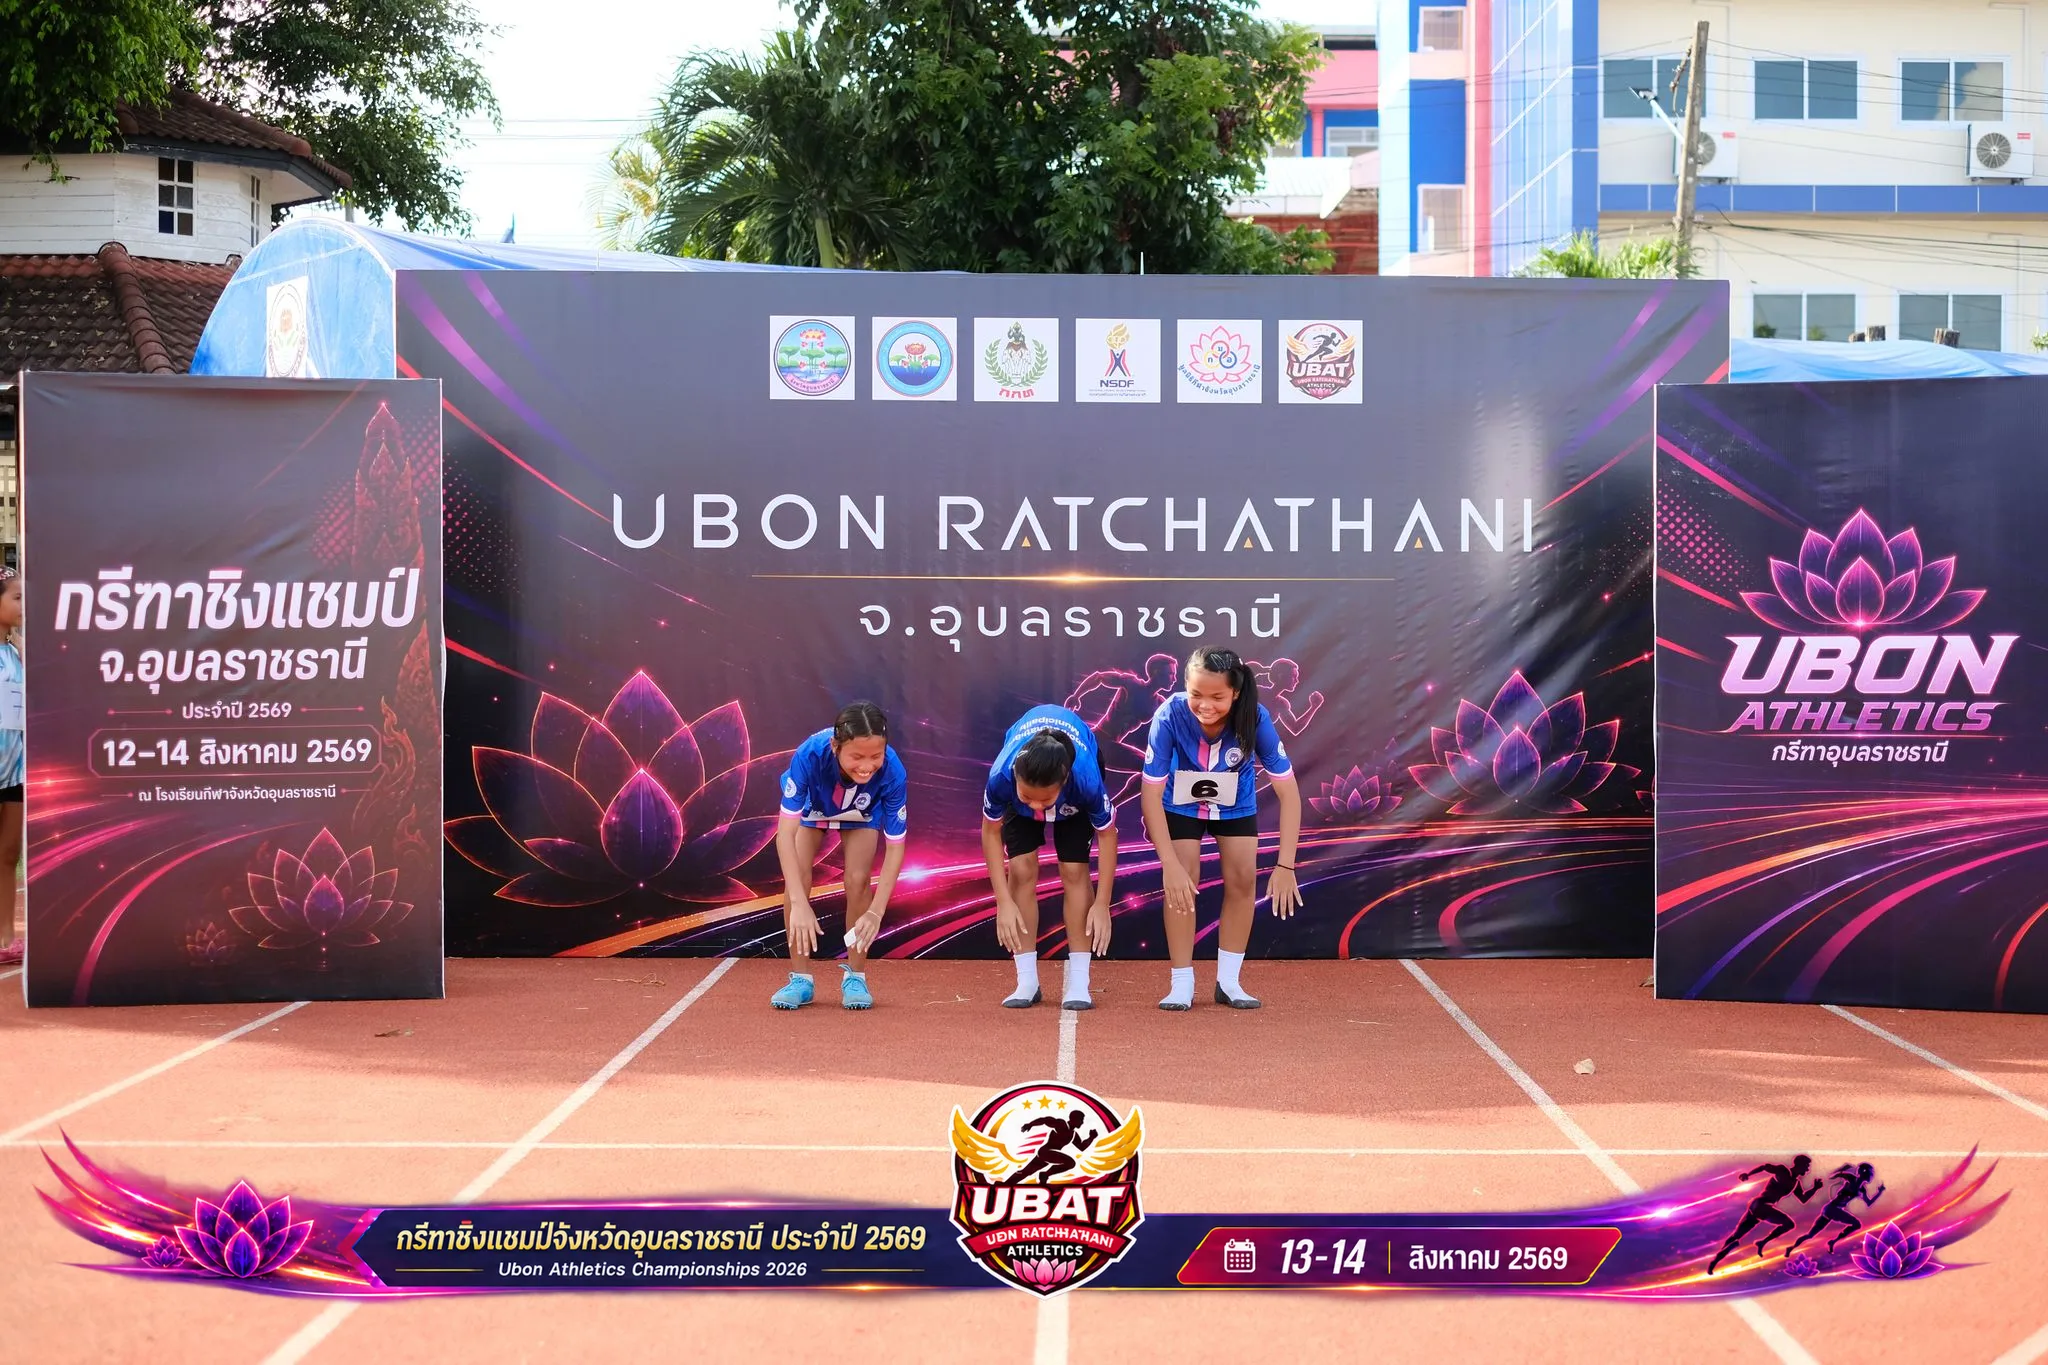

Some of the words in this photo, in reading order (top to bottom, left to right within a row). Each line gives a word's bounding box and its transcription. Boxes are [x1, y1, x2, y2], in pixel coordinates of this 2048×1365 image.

[1099, 379, 1135, 388] NSDF
[1292, 362, 1350, 377] UBAT
[613, 493, 885, 550] UBON
[938, 495, 1532, 552] RATCHATHANI
[859, 593, 1280, 653] จ.อุบลราชธานี
[99, 636, 368, 694] จ.อุบลราชธานี
[1720, 635, 2021, 694] UBON
[182, 701, 242, 719] ประจำปี
[248, 702, 292, 718] 2569
[1726, 701, 2004, 731] ATHLETICS
[200, 738, 297, 765] สิงหาคม
[307, 738, 372, 763] 2569
[1771, 739, 1950, 768] กรีฑาอุบลราชธานี
[138, 790, 152, 802] ณ
[155, 784, 337, 803] โรงเรียนกีฬาจังหวัดอุบลราชธานี
[1191, 779, 1219, 798] 6
